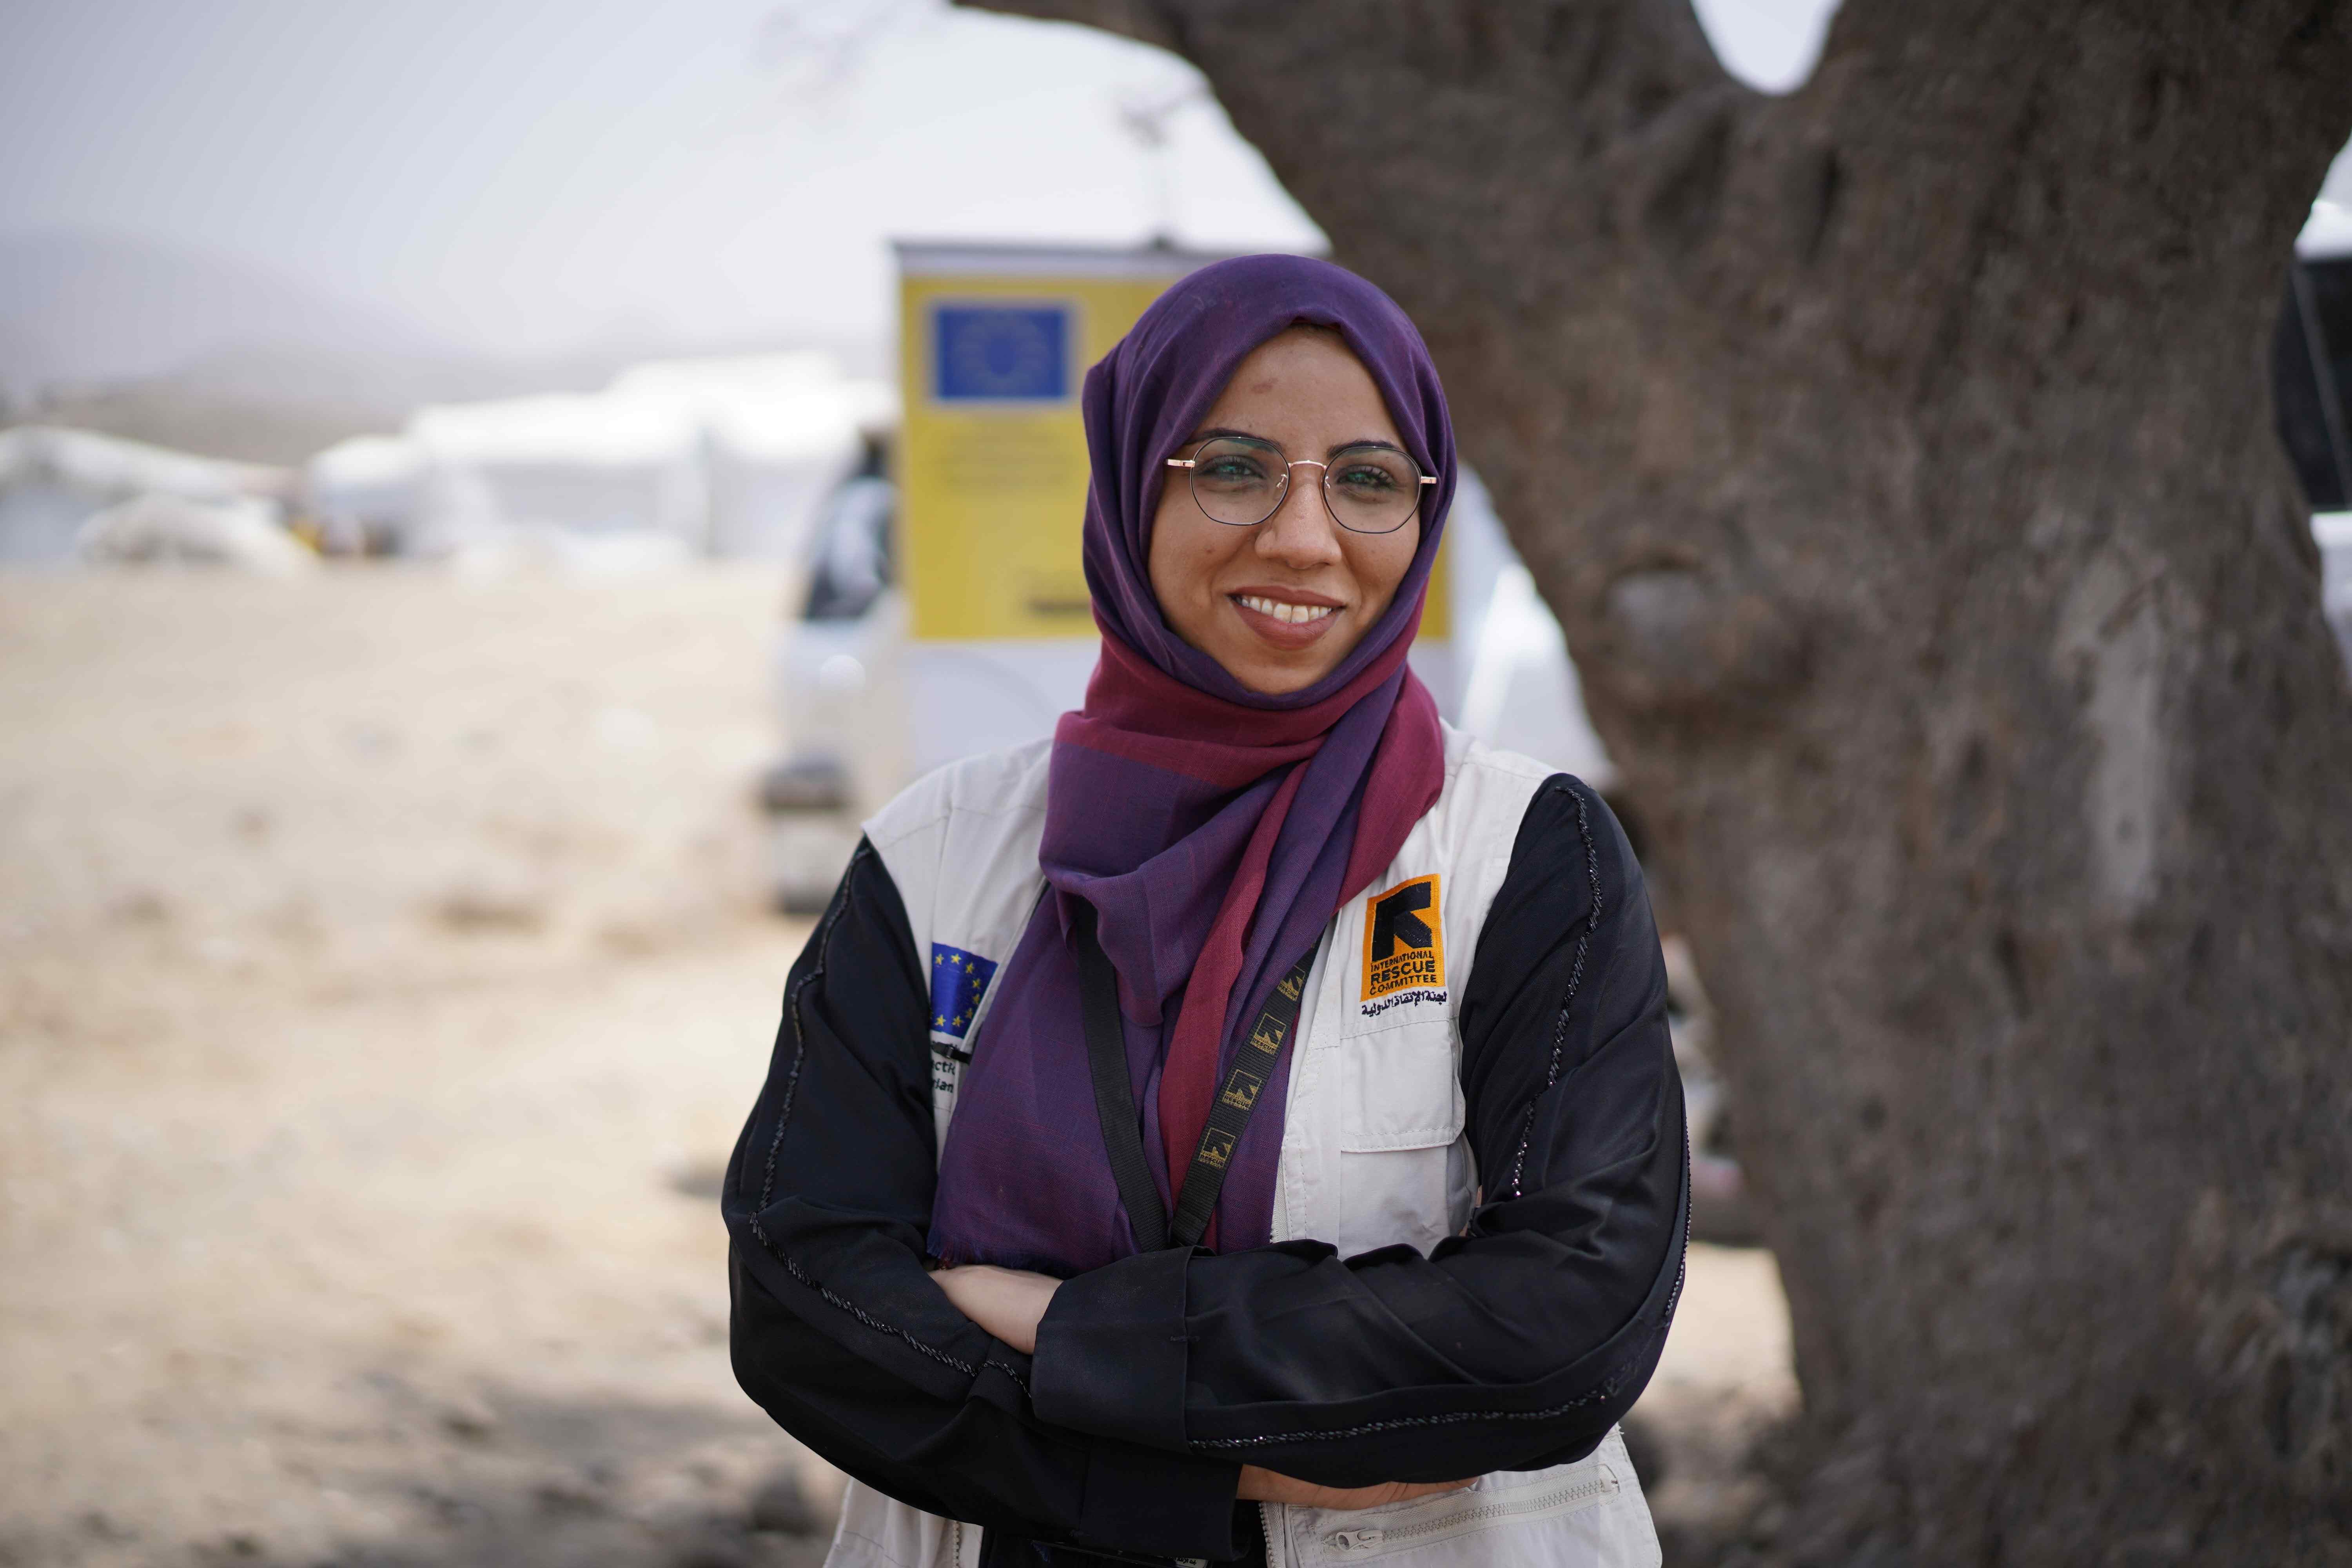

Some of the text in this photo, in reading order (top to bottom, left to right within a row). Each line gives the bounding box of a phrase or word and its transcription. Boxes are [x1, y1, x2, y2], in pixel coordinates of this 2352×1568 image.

[1370, 951, 1434, 972] INTERNATIONAL
[1370, 960, 1436, 985] RESCUE
[1279, 983, 1298, 998] RESCUE
[1370, 975, 1437, 995] COMMITTEE
[1254, 1039, 1277, 1053] RESCUE
